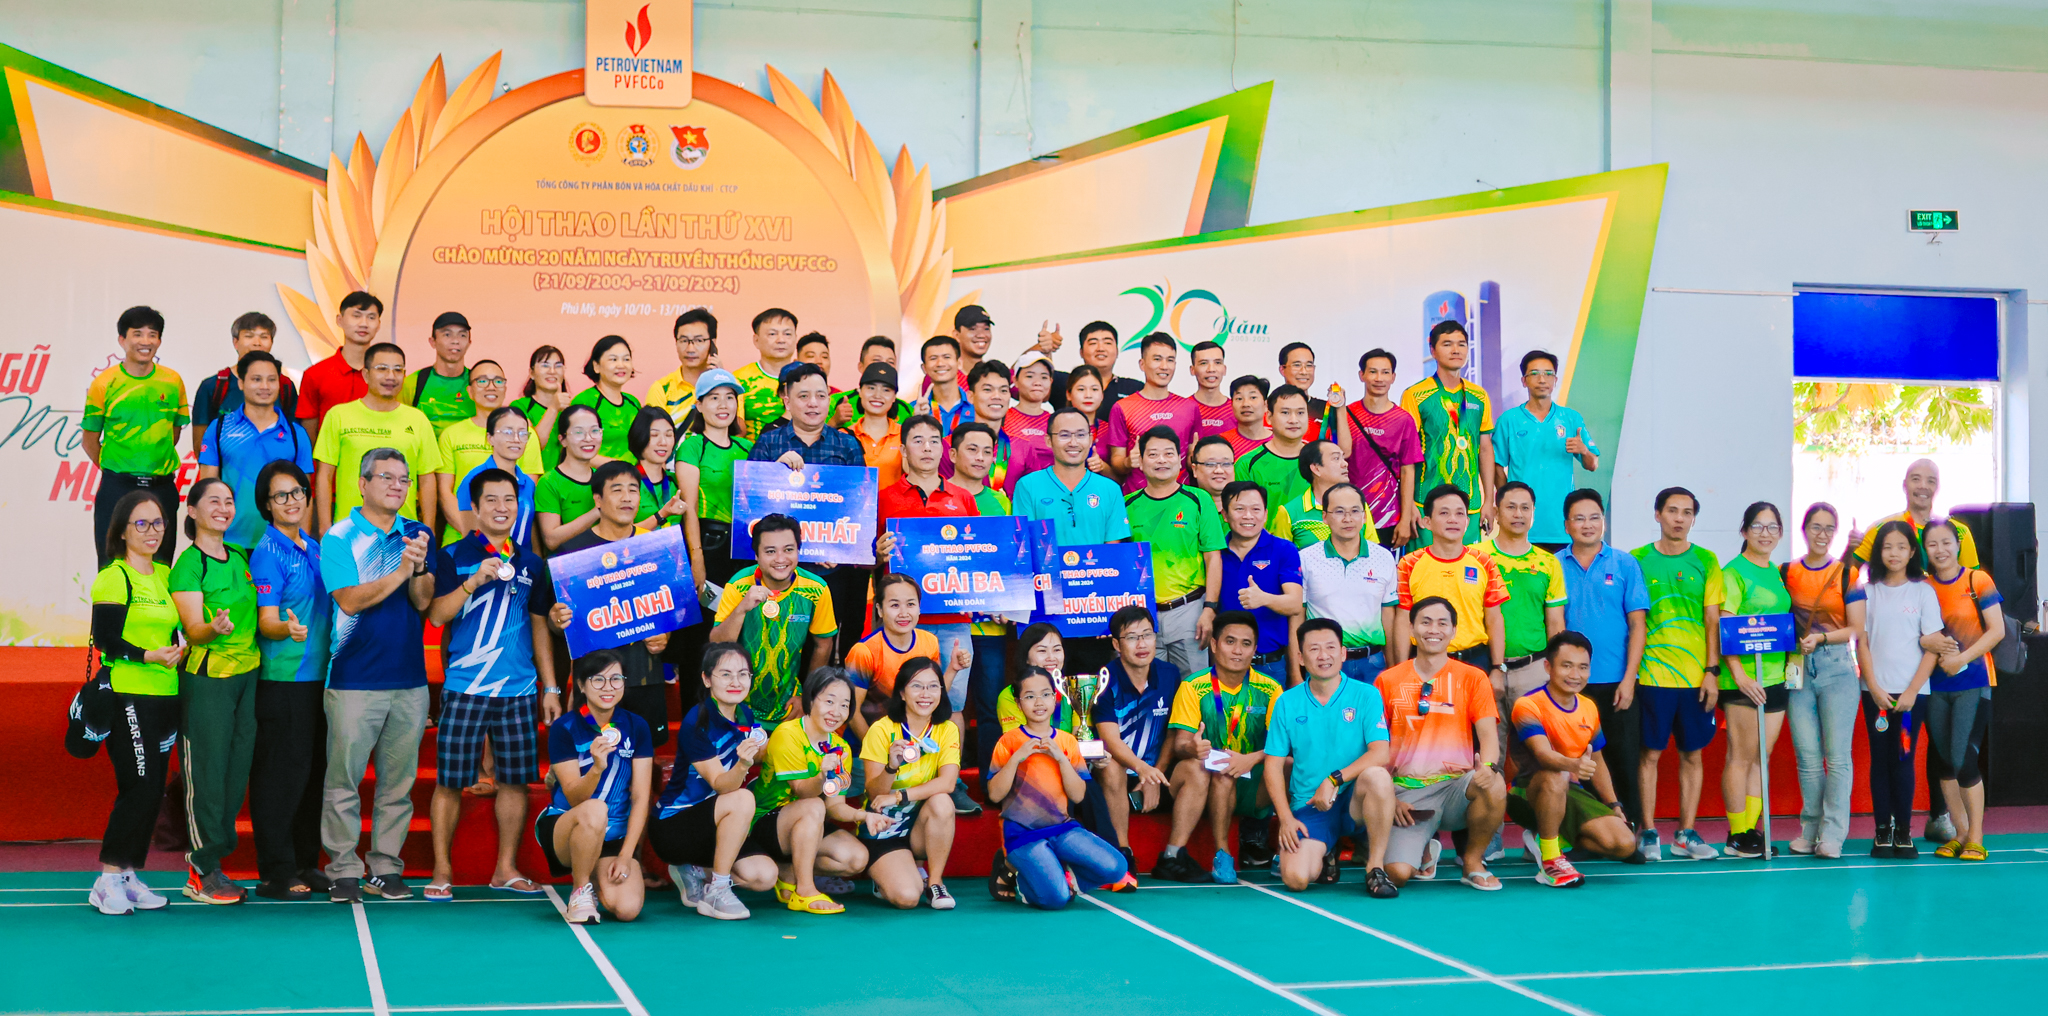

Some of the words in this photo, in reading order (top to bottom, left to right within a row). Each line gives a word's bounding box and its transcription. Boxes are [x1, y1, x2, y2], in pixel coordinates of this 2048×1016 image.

[596, 57, 682, 74] PETROVIETNAM
[614, 74, 664, 90] PVFCCo
[558, 180, 579, 190] CÔNG
[581, 181, 590, 190] TY
[481, 205, 533, 242] HỘI
[537, 211, 616, 238] THAO
[621, 206, 677, 239] LẦN
[680, 210, 742, 240] THỨ
[744, 215, 792, 241] XVI
[434, 244, 481, 265] CHÀO
[482, 245, 536, 266] MỪNG
[538, 249, 561, 267] 20
[561, 247, 602, 268] NĂM
[603, 248, 649, 268] NGÀY
[714, 249, 775, 270] THỐNG
[776, 254, 838, 273] PVFCCo
[560, 302, 580, 315] Phú
[598, 304, 623, 318] ngày
[624, 303, 652, 316] 10/10
[785, 491, 810, 502] THAO
[810, 492, 844, 503] PVFCCo
[800, 516, 861, 544] NHẤT
[922, 543, 939, 556] HỘI
[939, 545, 964, 554] THAO
[964, 543, 998, 553] PVFCCo
[587, 576, 604, 590] HỘI
[603, 569, 626, 584] THAO
[626, 562, 658, 579] PVFCCo
[922, 566, 970, 594] GIẢI
[972, 571, 1006, 593] BA
[1062, 570, 1086, 579] THAO
[1086, 568, 1119, 578] PVFCCo
[587, 596, 634, 631] GIẢI
[633, 584, 675, 619] NHÌ
[944, 598, 964, 607] TOÀN
[1063, 592, 1106, 614] HUYẾN
[616, 629, 635, 639] TOÀN
[635, 622, 655, 634] ĐOÀN
[1745, 642, 1772, 651] PSE
[124, 704, 141, 740] WEAR
